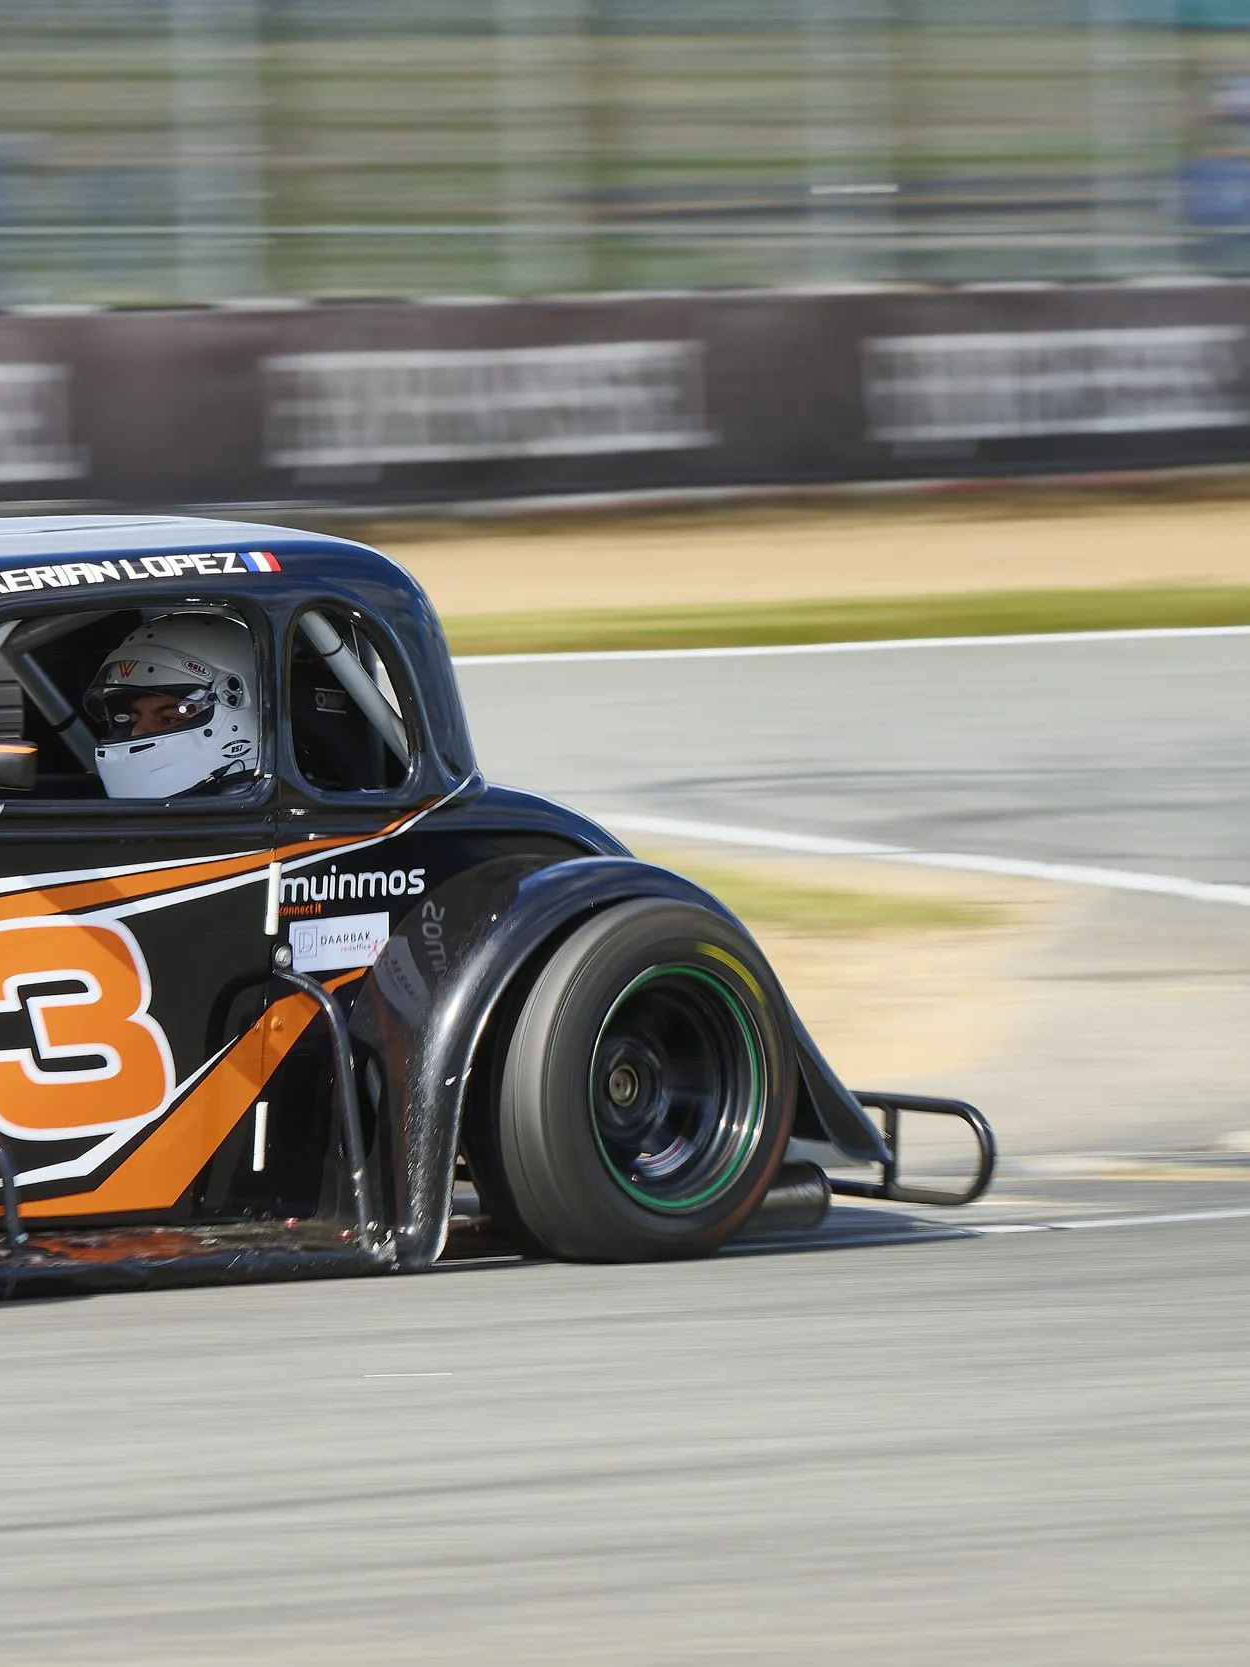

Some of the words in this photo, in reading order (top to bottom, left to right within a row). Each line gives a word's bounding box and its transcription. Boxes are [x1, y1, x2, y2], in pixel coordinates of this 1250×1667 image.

[119, 553, 247, 580] LOPEZ
[280, 864, 426, 904] muinmos
[279, 903, 313, 916] connect
[320, 931, 371, 946] DAARBAK
